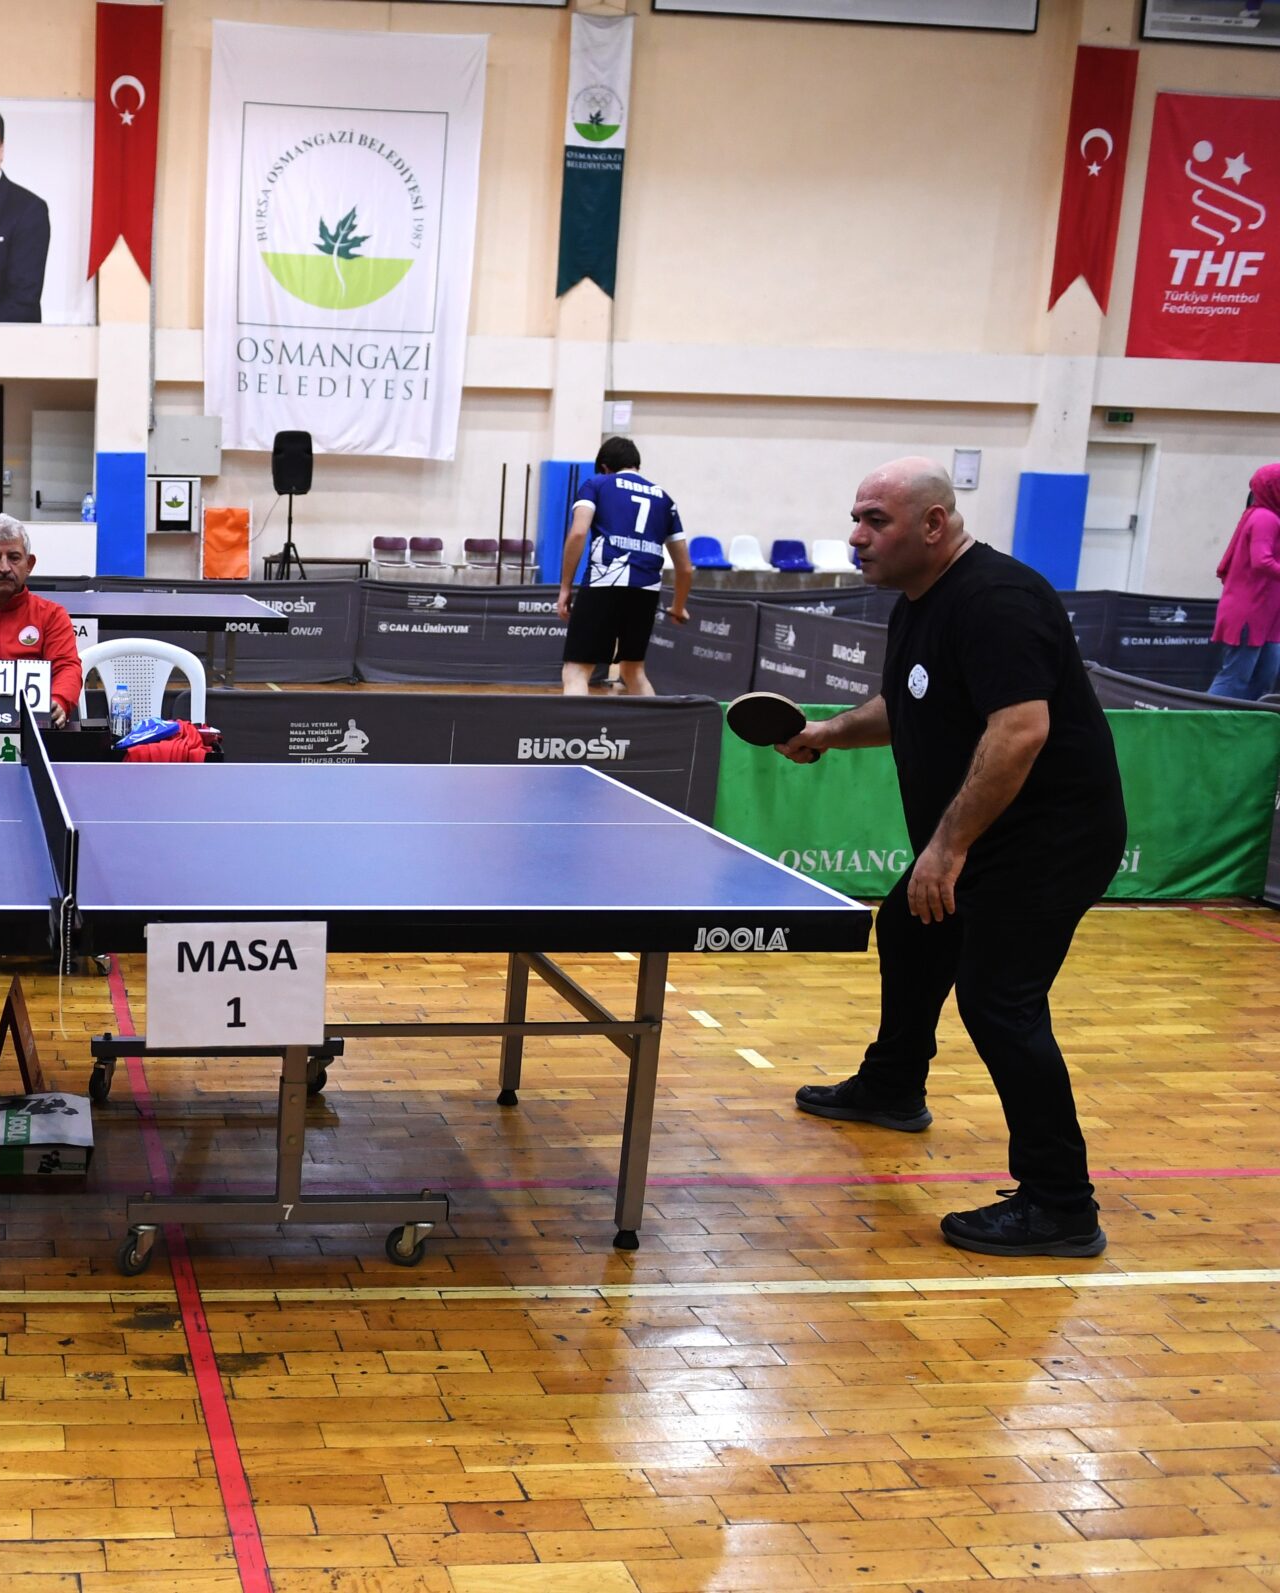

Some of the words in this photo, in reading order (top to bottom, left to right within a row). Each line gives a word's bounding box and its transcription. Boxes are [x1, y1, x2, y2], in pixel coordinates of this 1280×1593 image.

[257, 188, 272, 242] BURSA
[266, 128, 355, 184] OSMANGAZİ
[358, 134, 427, 213] BELEDİYESİ
[411, 217, 425, 249] 1987
[1169, 249, 1266, 287] THF
[1164, 290, 1208, 304] Türkiye
[1211, 293, 1260, 303] Hentbol
[1162, 303, 1241, 317] Federasyonu
[236, 336, 431, 372] OSMANGAZİ
[237, 371, 430, 401] BELEDİYESİ
[615, 477, 664, 499] ERDEM
[630, 495, 651, 534] 7
[225, 621, 260, 632] JOOLA
[291, 626, 323, 636] ONUR
[389, 623, 410, 632] CAN
[411, 622, 470, 633] ALÜMİNYUM
[508, 625, 548, 636] SEÇKİN
[1131, 637, 1151, 645] CAN
[1152, 635, 1209, 645] ALÜMİNYUM
[0, 667, 8, 693] 1
[24, 672, 42, 708] 5
[307, 728, 342, 736] TENİSÇİLERİ
[778, 849, 908, 873] OSMANG
[693, 926, 791, 951] JOOLA
[177, 939, 298, 973] MASA
[226, 997, 246, 1028] 1
[283, 1204, 295, 1221] 7
